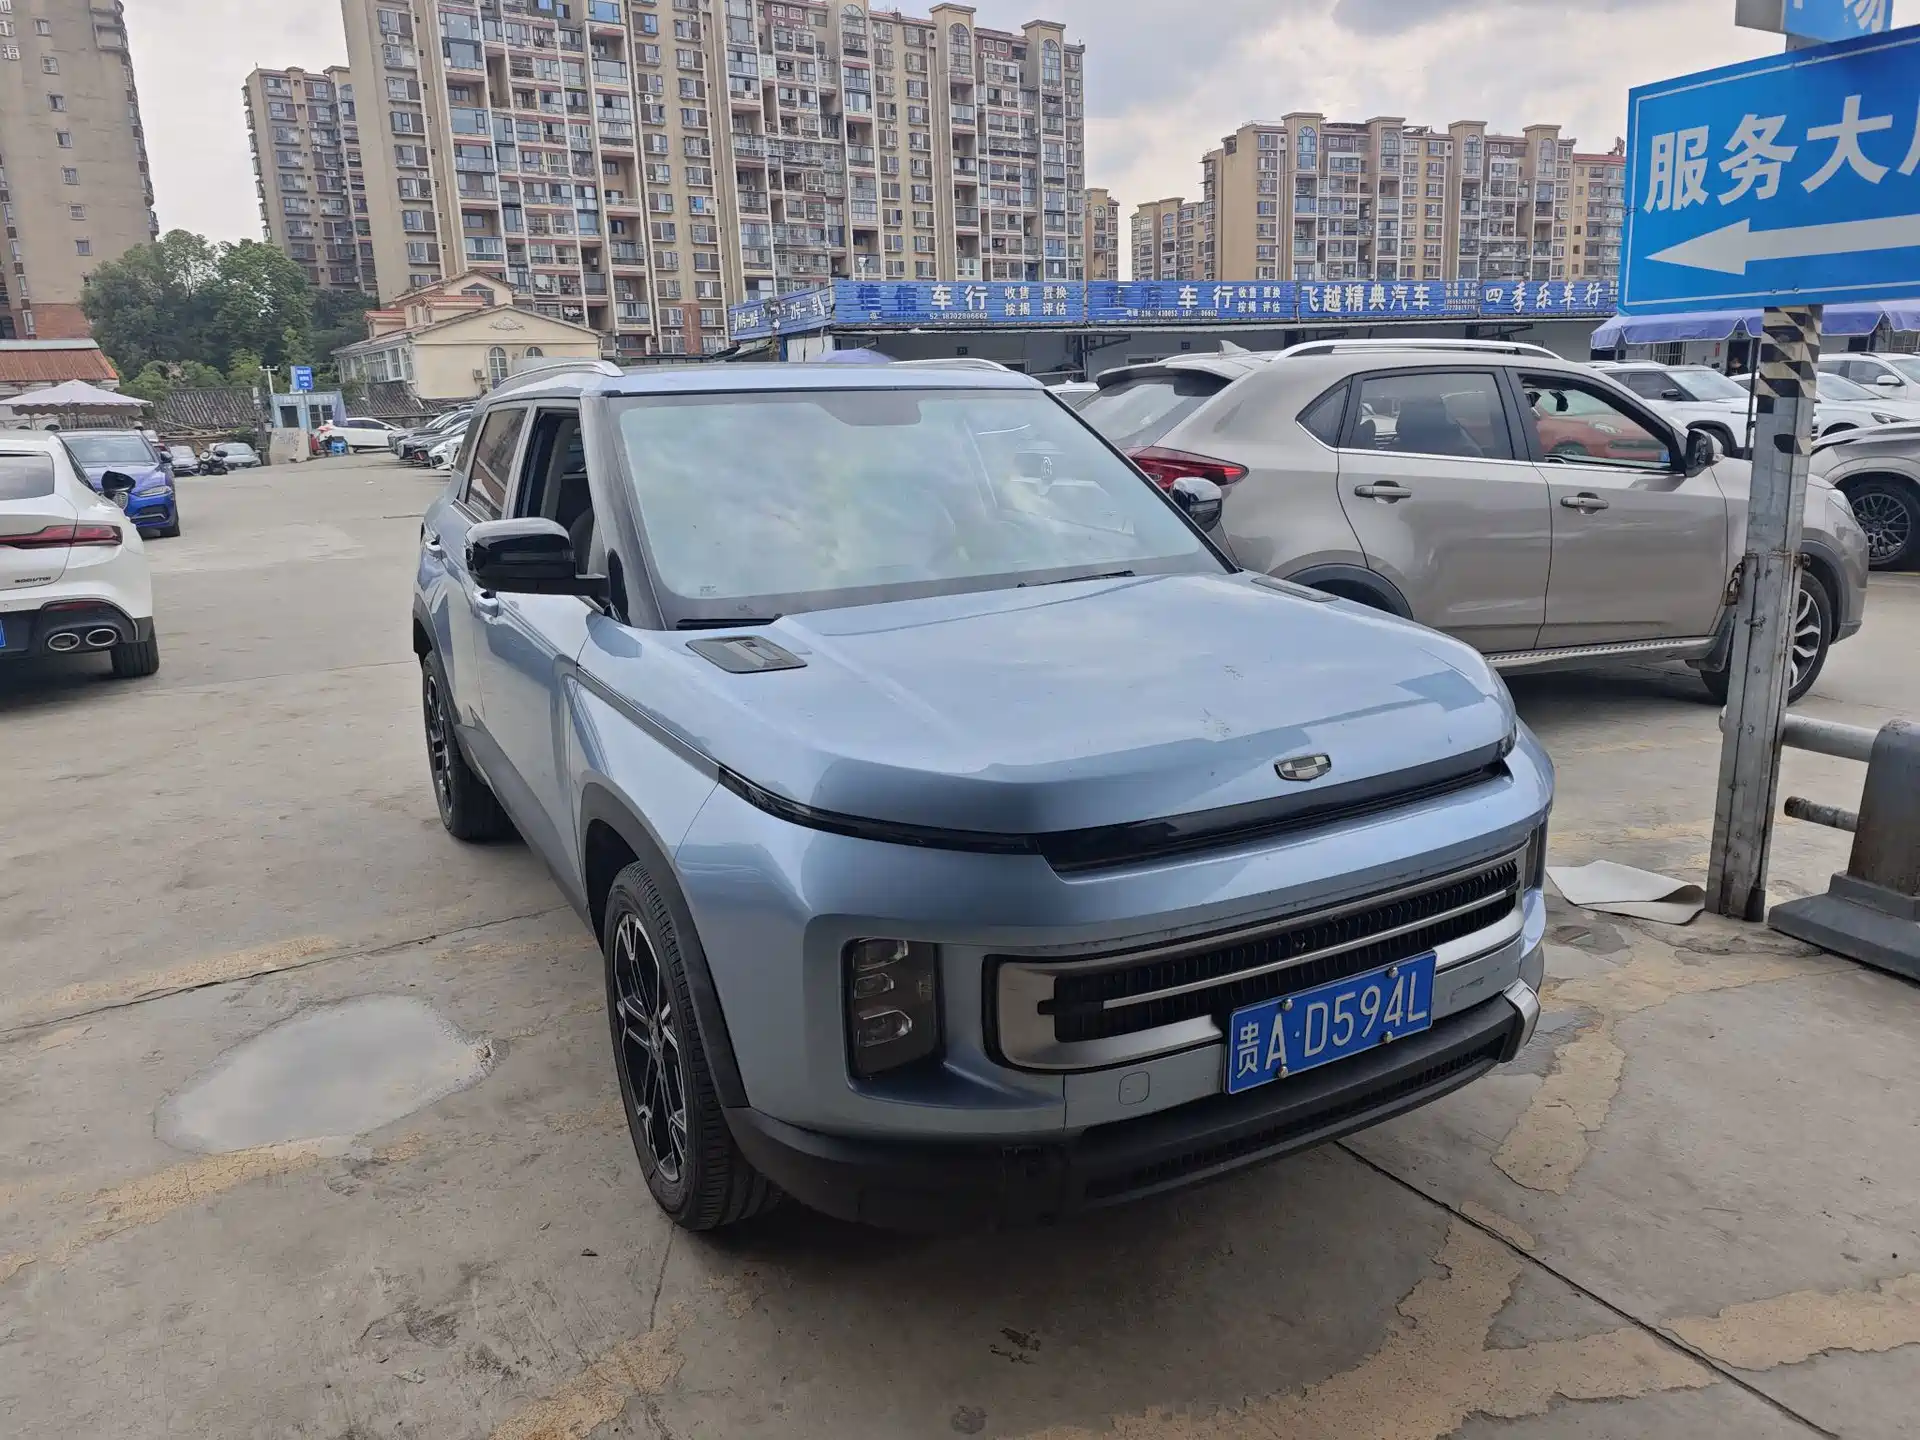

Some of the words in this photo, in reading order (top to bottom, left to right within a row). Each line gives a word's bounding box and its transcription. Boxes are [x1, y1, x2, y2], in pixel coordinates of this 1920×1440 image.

[1643, 94, 1920, 213] 服务大
[1005, 286, 1030, 299] 收售
[1043, 286, 1067, 299] 置换
[1302, 283, 1430, 312] 飞越精典汽车
[1005, 302, 1030, 316] 按揭
[1042, 302, 1067, 316] 评估
